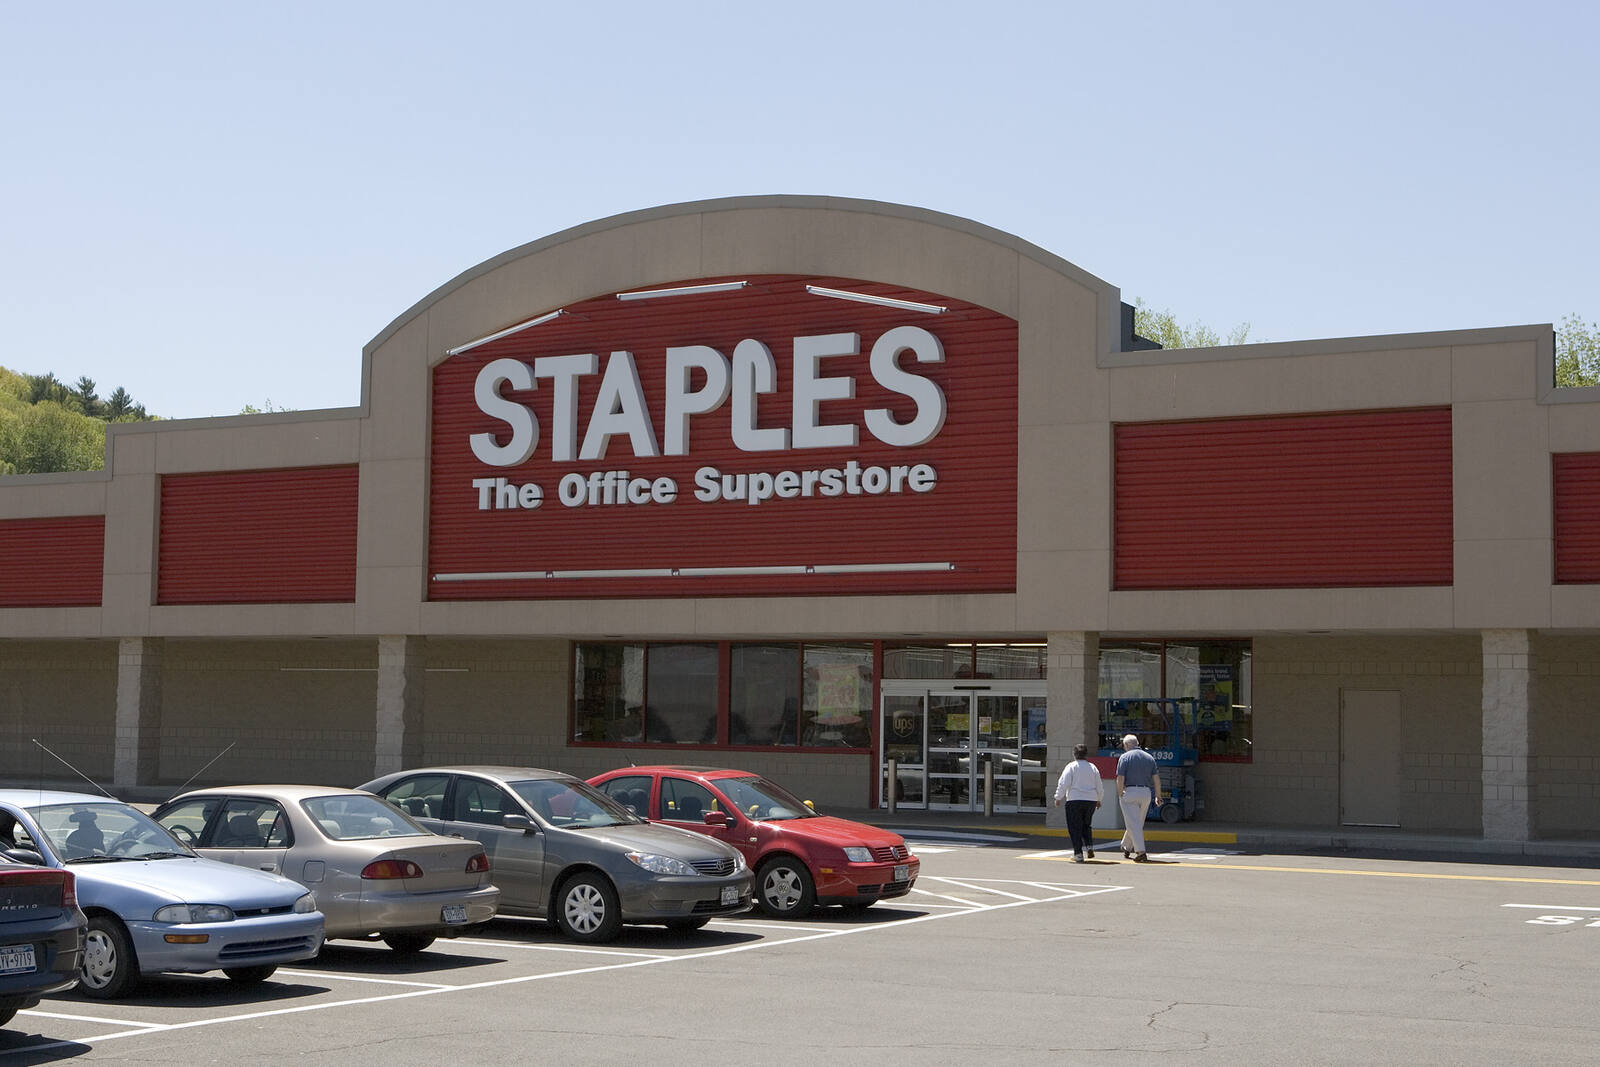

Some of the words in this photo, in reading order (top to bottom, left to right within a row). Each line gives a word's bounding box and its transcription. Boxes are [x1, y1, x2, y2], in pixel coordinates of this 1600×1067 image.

[470, 326, 946, 467] STAPLES
[472, 477, 543, 511] The
[558, 470, 678, 508] Office
[693, 460, 937, 506] Superstore
[894, 719, 913, 734] ups
